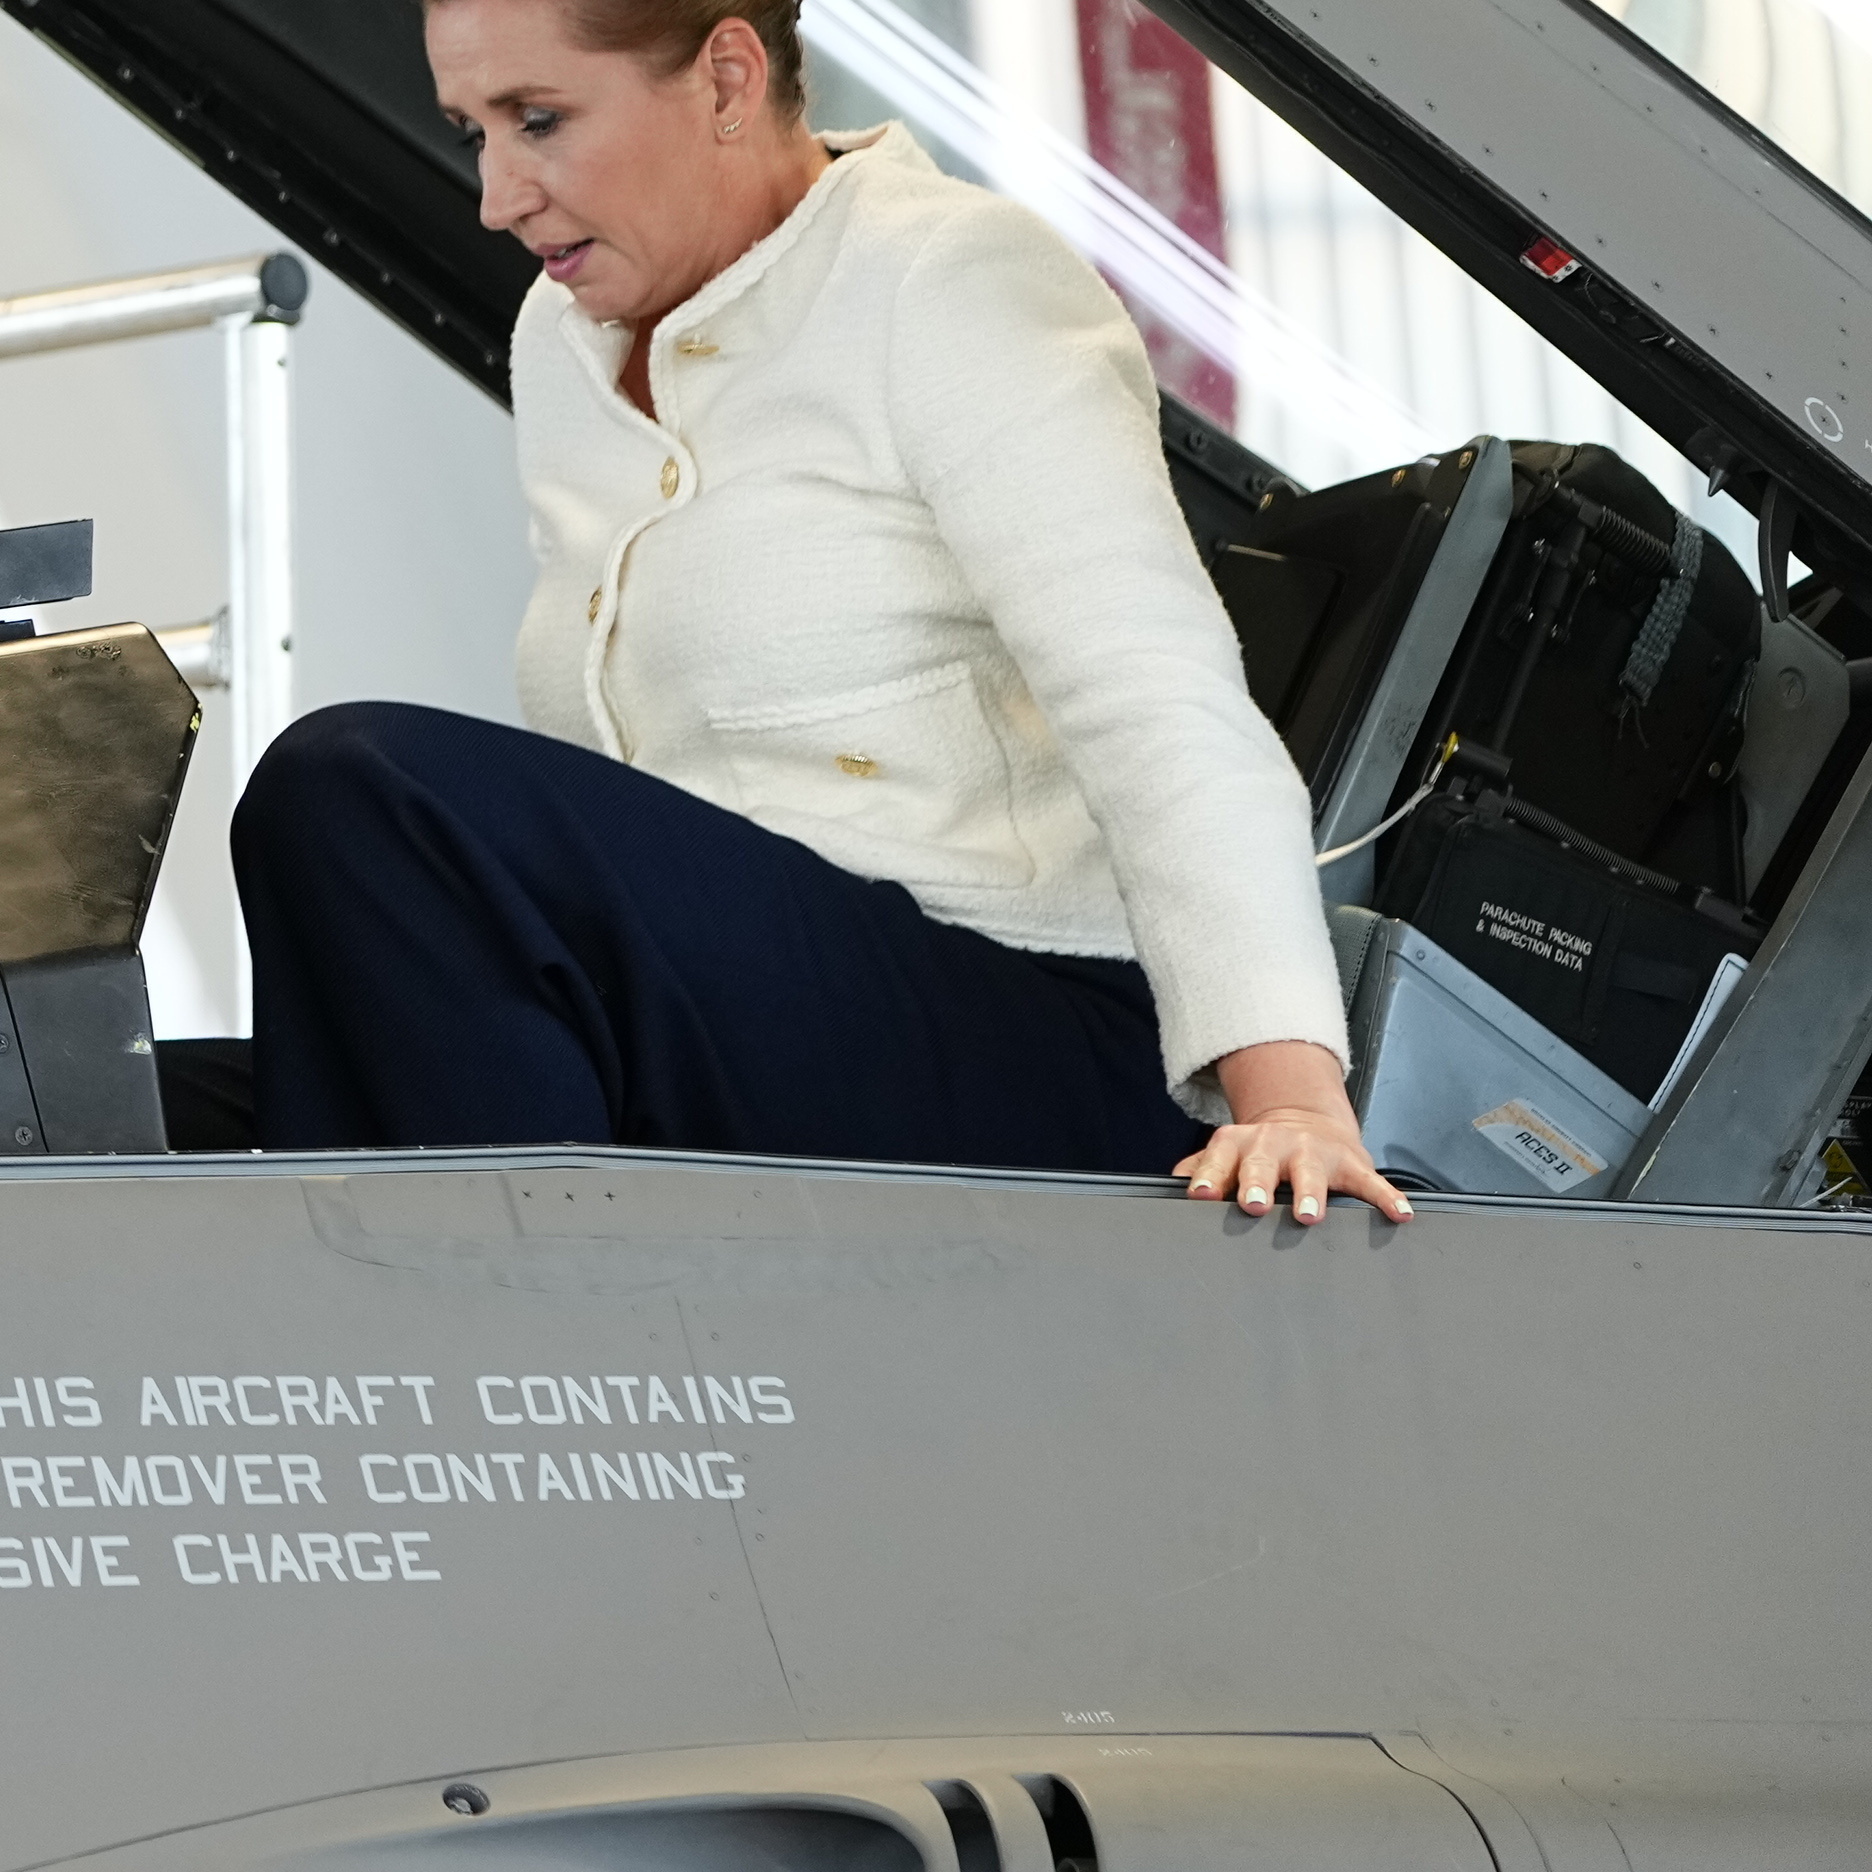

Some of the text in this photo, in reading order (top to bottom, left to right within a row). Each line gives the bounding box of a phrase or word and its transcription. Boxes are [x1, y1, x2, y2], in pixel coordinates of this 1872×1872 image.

[1476, 918, 1583, 972] & INSPECTION DATA
[1480, 901, 1593, 956] PARACHUTE PACKING
[1515, 1131, 1559, 1164] ACES
[140, 1376, 435, 1426] AIRCRAFT
[476, 1375, 795, 1425] CONTAINS
[0, 1454, 327, 1508] REMOVER
[359, 1452, 745, 1503] CONTAINING
[172, 1531, 441, 1584] CHARGE
